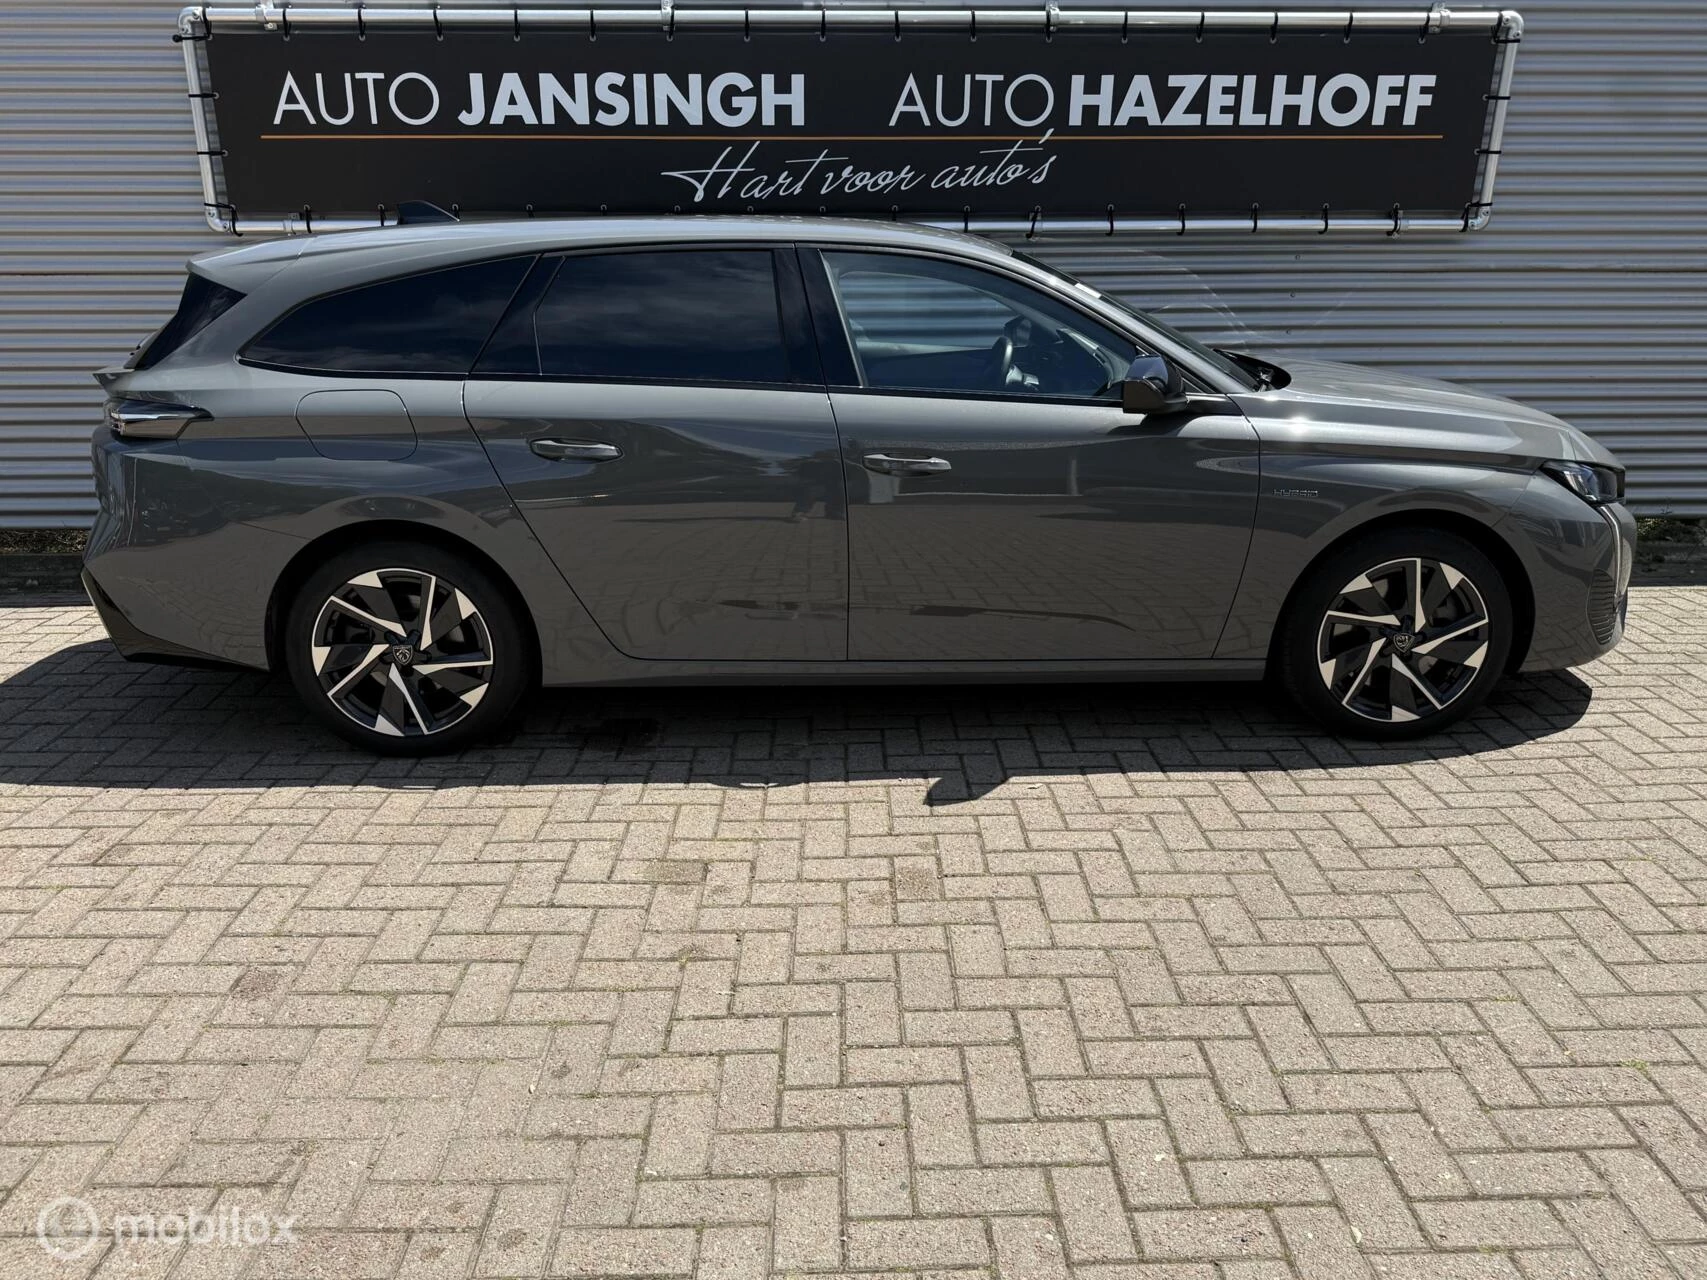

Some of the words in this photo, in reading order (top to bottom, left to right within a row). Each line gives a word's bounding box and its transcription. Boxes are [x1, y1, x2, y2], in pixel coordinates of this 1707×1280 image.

[273, 71, 439, 126] AUTO
[458, 72, 805, 127] JANSINGH
[889, 72, 1054, 127] AUTO
[1067, 73, 1436, 127] HAZELHOFF
[661, 140, 849, 202] Hart
[820, 164, 925, 195] voor
[930, 128, 1057, 189] auto's
